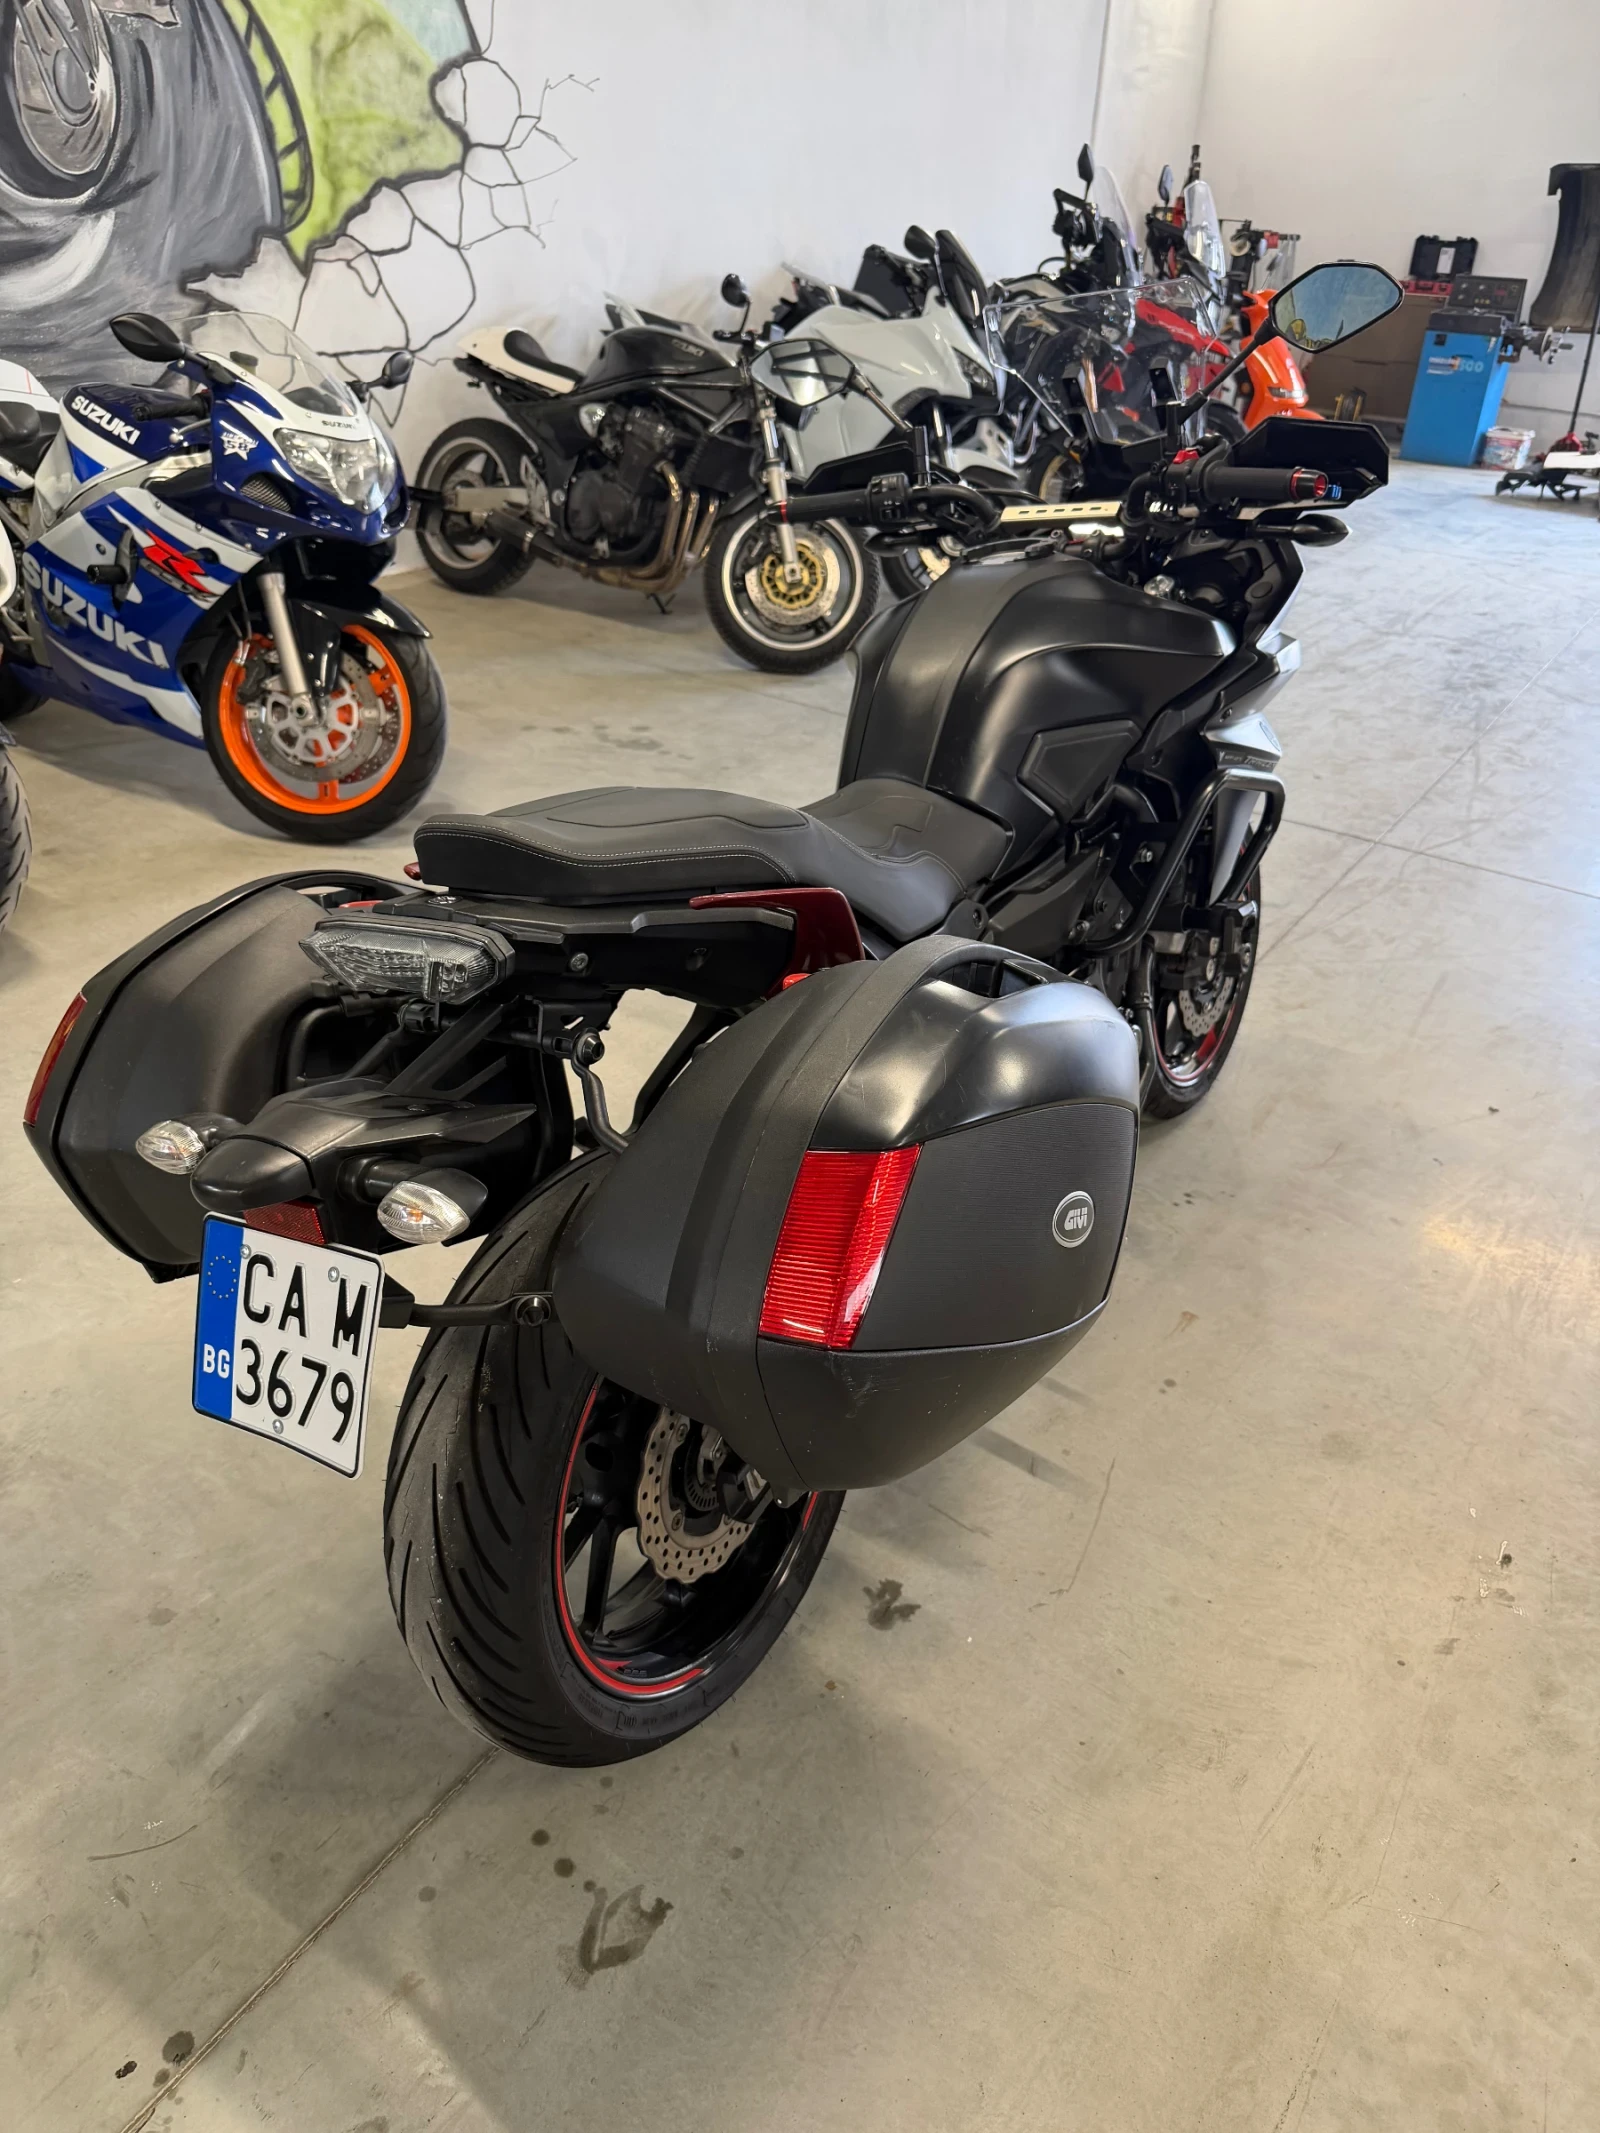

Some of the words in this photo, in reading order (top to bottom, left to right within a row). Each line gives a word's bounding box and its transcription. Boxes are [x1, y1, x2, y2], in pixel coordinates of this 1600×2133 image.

[71, 395, 141, 446] SUZUKI
[22, 552, 170, 669] SUZUKI
[1064, 1207, 1088, 1231] GIVI
[243, 1254, 307, 1338] CA
[332, 1278, 368, 1357] M
[203, 1343, 230, 1379] BG
[236, 1339, 354, 1443] 3679
